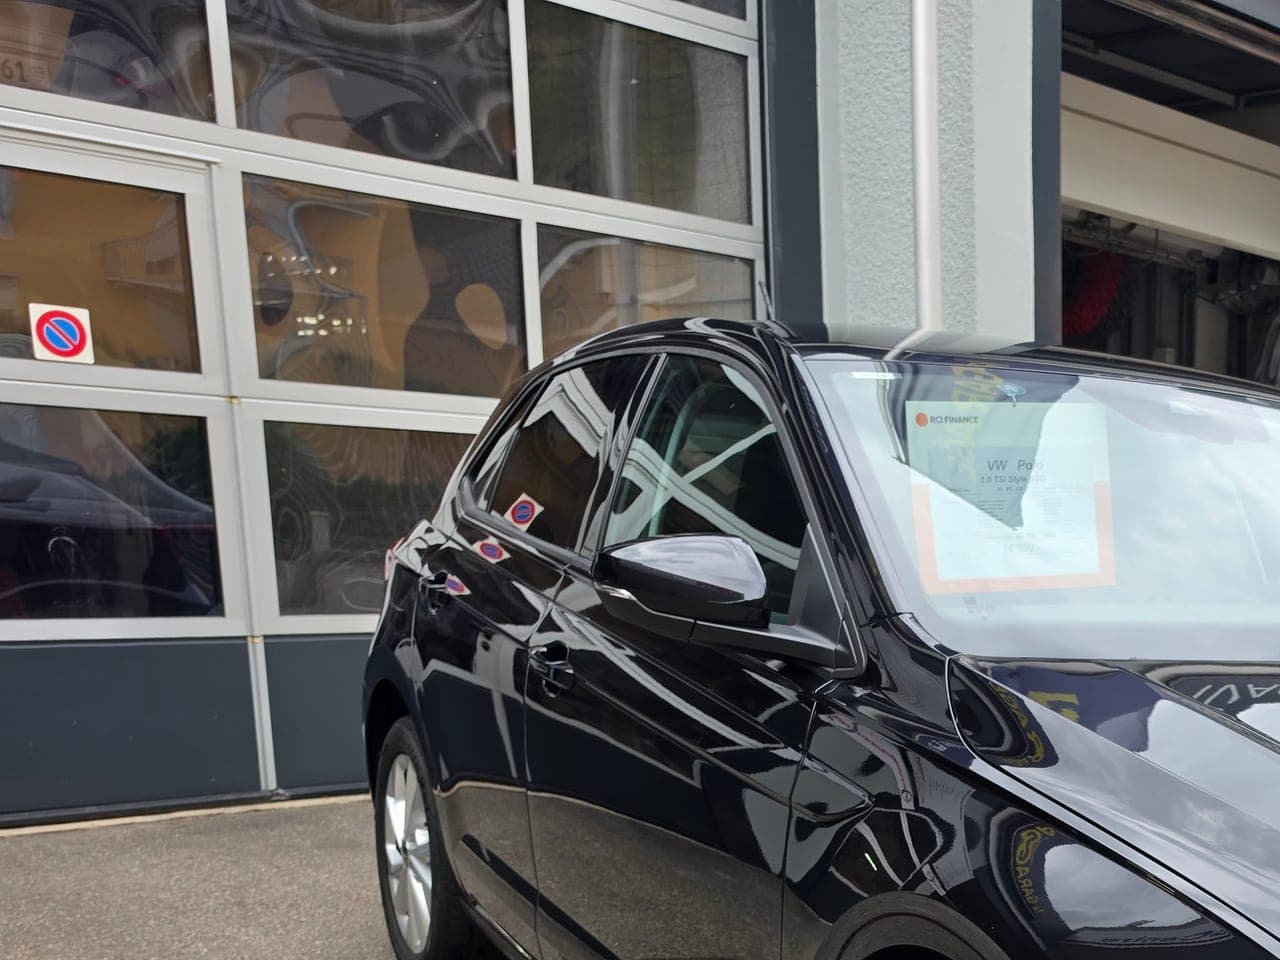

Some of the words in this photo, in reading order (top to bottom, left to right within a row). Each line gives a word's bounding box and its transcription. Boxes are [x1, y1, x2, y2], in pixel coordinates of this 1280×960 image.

[944, 415, 980, 424] FINANCE
[986, 459, 1008, 472] VW
[1017, 459, 1044, 472] Poo
